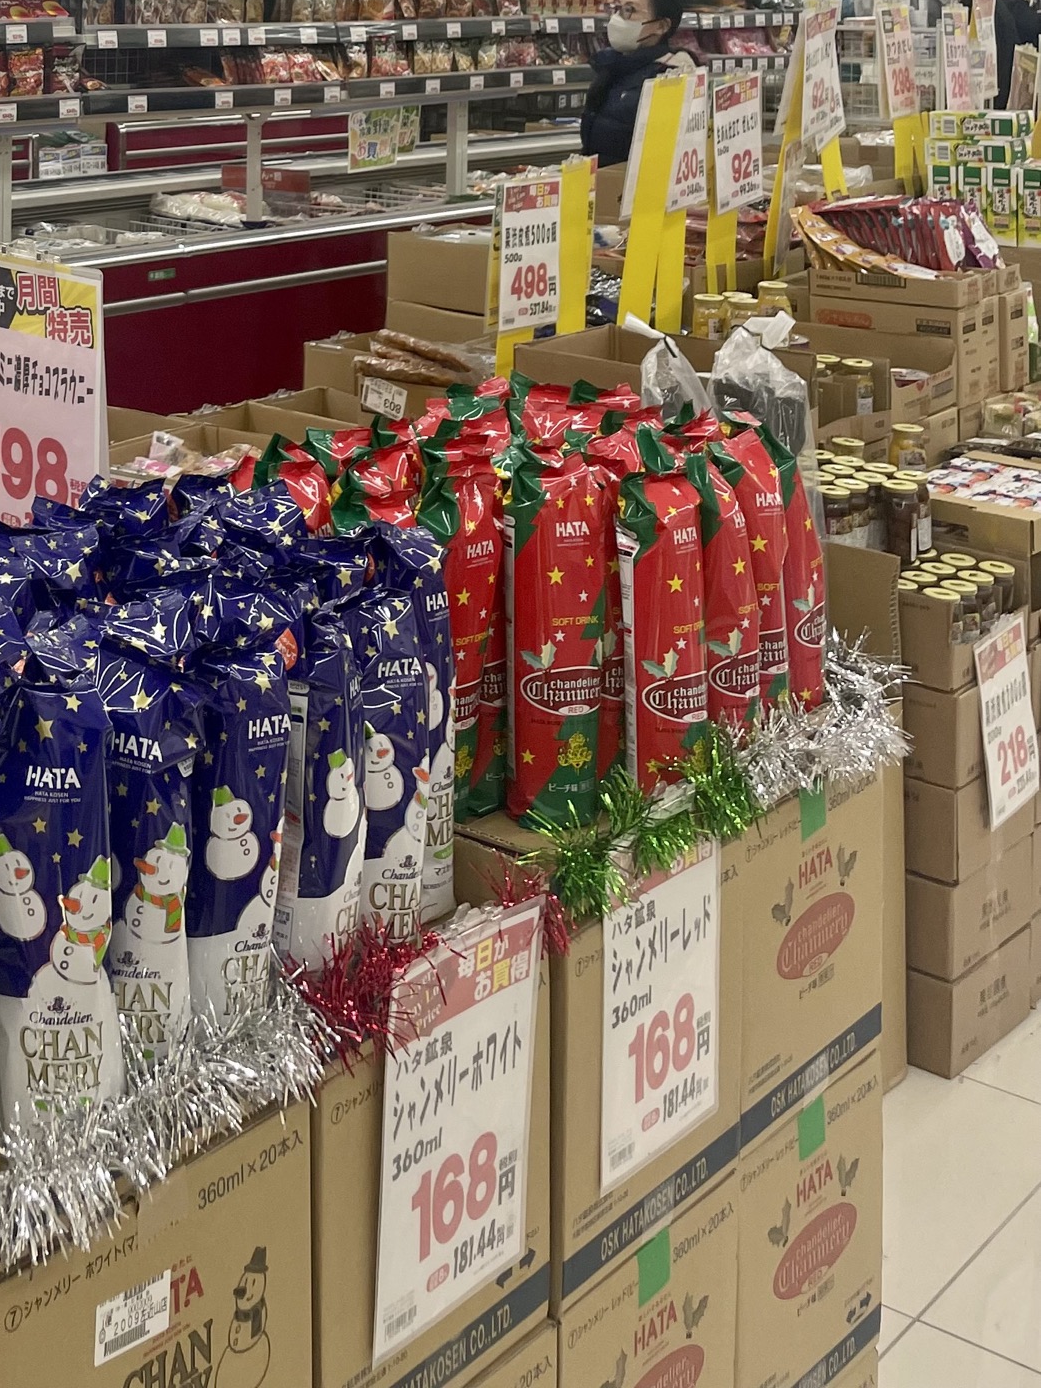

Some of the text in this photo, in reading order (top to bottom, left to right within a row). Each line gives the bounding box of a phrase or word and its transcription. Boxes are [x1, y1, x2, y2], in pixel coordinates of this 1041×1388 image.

[505, 253, 523, 264] 500g
[15, 272, 60, 309] 月間
[46, 309, 94, 348] 特売
[555, 520, 591, 539] HATA
[673, 526, 698, 546] HATA
[466, 539, 495, 560] HATA
[757, 582, 781, 592] SOFT
[551, 614, 600, 627] SOFT DRINK
[673, 625, 693, 636] SOFT
[377, 656, 423, 680] HATA
[550, 675, 601, 690] chandelier
[248, 713, 293, 741] HATA
[567, 705, 584, 714] RED
[112, 730, 164, 763] HATA
[26, 765, 82, 790] HATA
[548, 783, 579, 794] ピーチ味
[798, 845, 833, 890] HATA
[611, 899, 657, 941] ハタ鉱泉
[457, 934, 510, 980] 毎日が
[611, 893, 713, 995] シャンメリーレッド
[473, 949, 531, 1002] お買得
[611, 984, 652, 1030] 360ml
[19, 1019, 103, 1061] CHAN
[395, 1030, 454, 1083] ハタ鉱泉
[391, 1020, 524, 1142] シャンメリーホワイト
[770, 1092, 787, 1118] OSK
[391, 1126, 444, 1181] 360ml
[796, 1159, 834, 1208] HATA
[600, 1231, 621, 1262] OSK
[621, 1186, 675, 1241] HATAKOSEN
[633, 1300, 679, 1358] HATA
